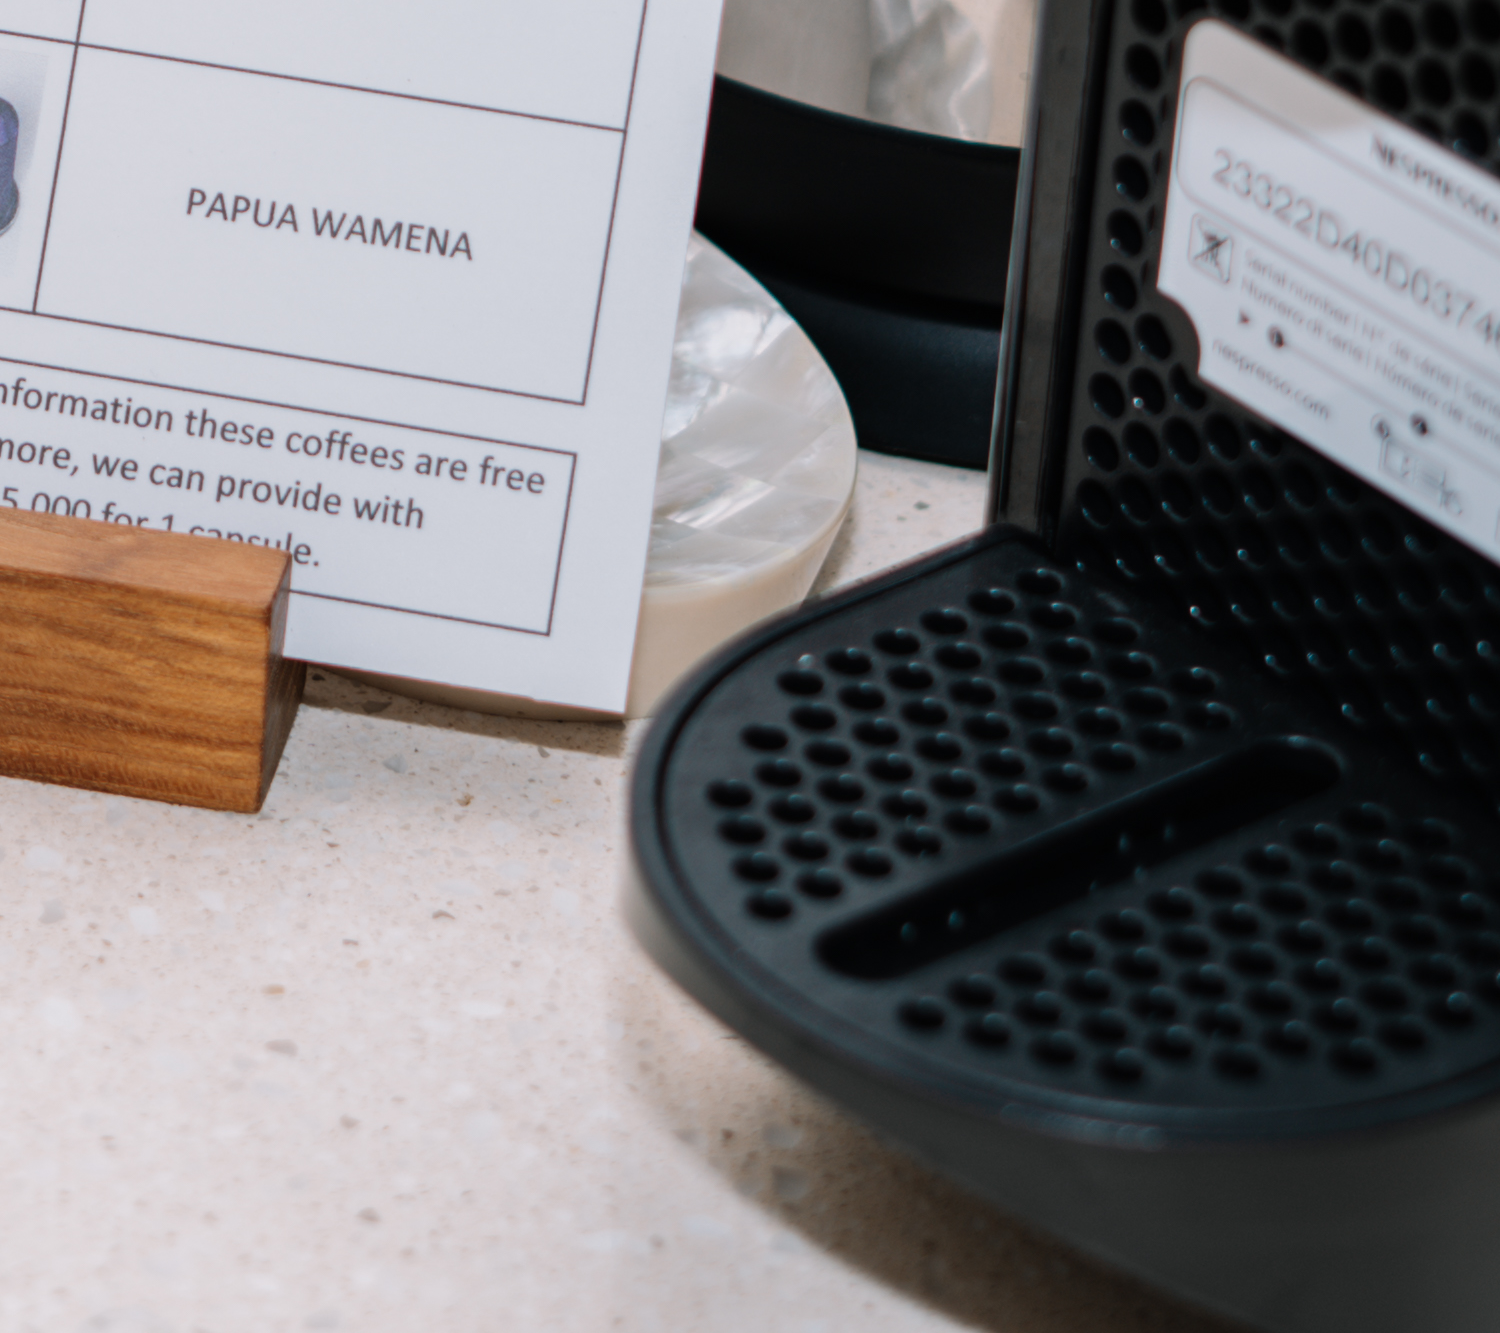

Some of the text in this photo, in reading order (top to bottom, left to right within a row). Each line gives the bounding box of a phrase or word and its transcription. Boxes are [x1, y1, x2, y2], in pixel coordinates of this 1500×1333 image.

[185, 187, 473, 262] PAPUA WAMENA
[184, 407, 275, 450] these
[284, 428, 405, 472] coffees
[413, 452, 469, 482] are
[478, 454, 546, 495] free
[91, 453, 139, 482] we
[148, 463, 206, 493] can
[215, 474, 342, 516] provide
[352, 494, 425, 530] with
